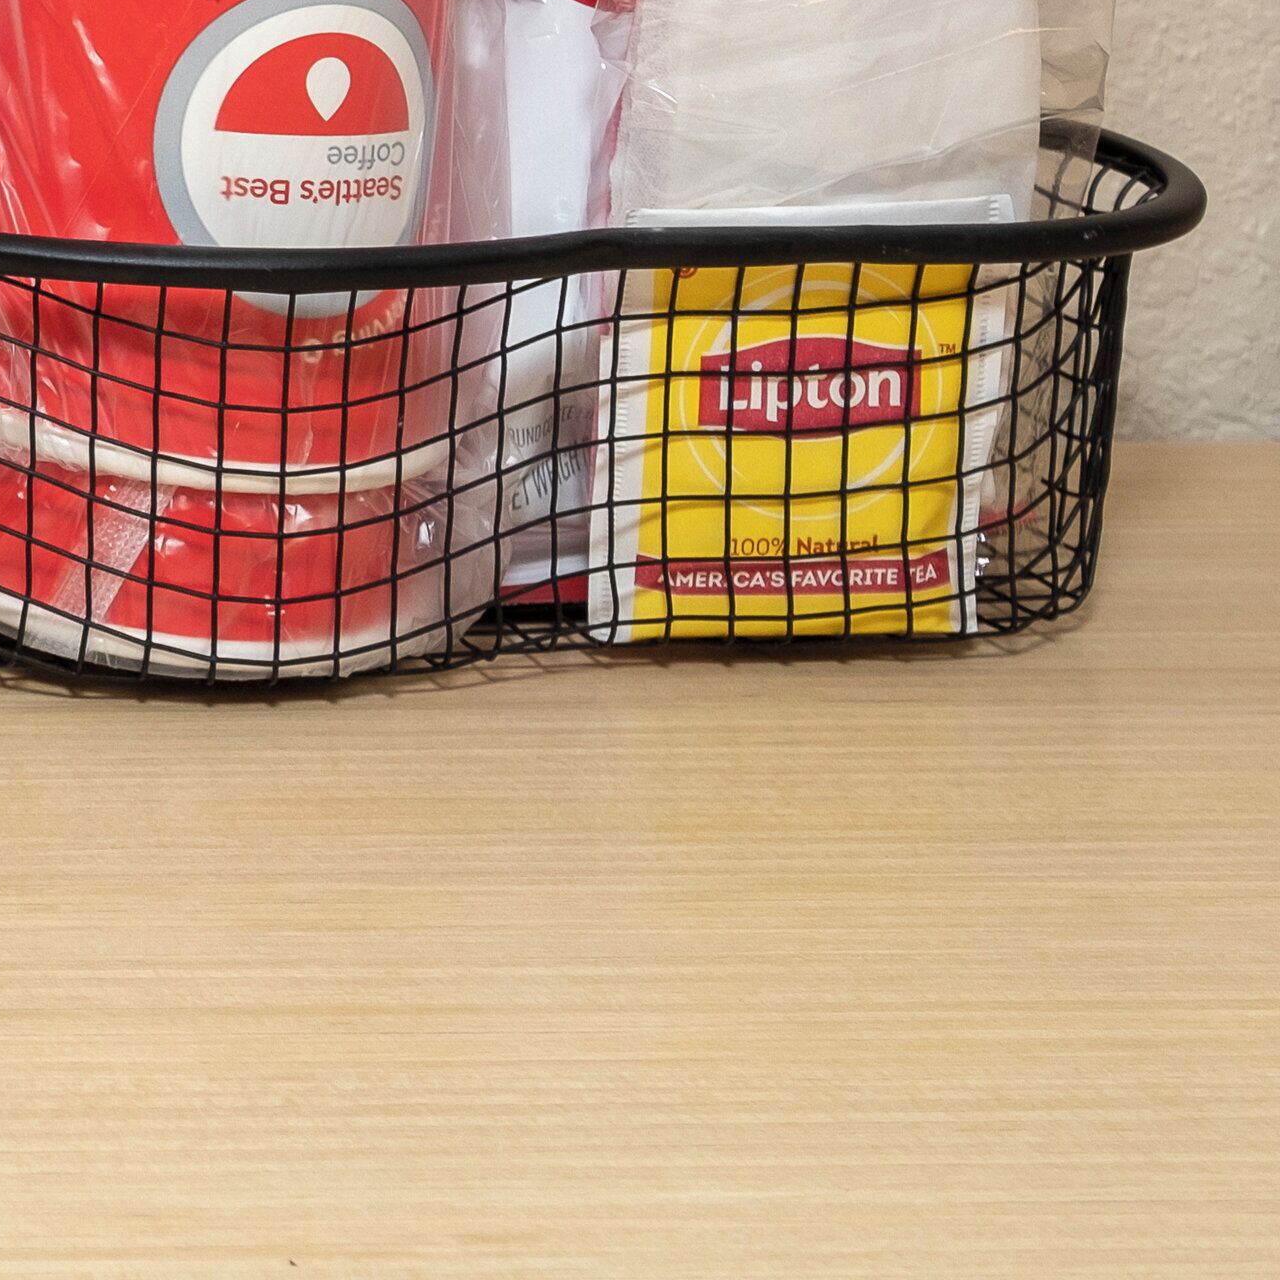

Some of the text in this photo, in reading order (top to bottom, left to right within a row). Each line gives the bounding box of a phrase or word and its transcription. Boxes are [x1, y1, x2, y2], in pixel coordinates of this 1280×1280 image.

[326, 141, 406, 171] Coffee
[220, 174, 404, 207] Seattle's Best
[718, 360, 902, 423] Lipton
[731, 537, 786, 557] 100%
